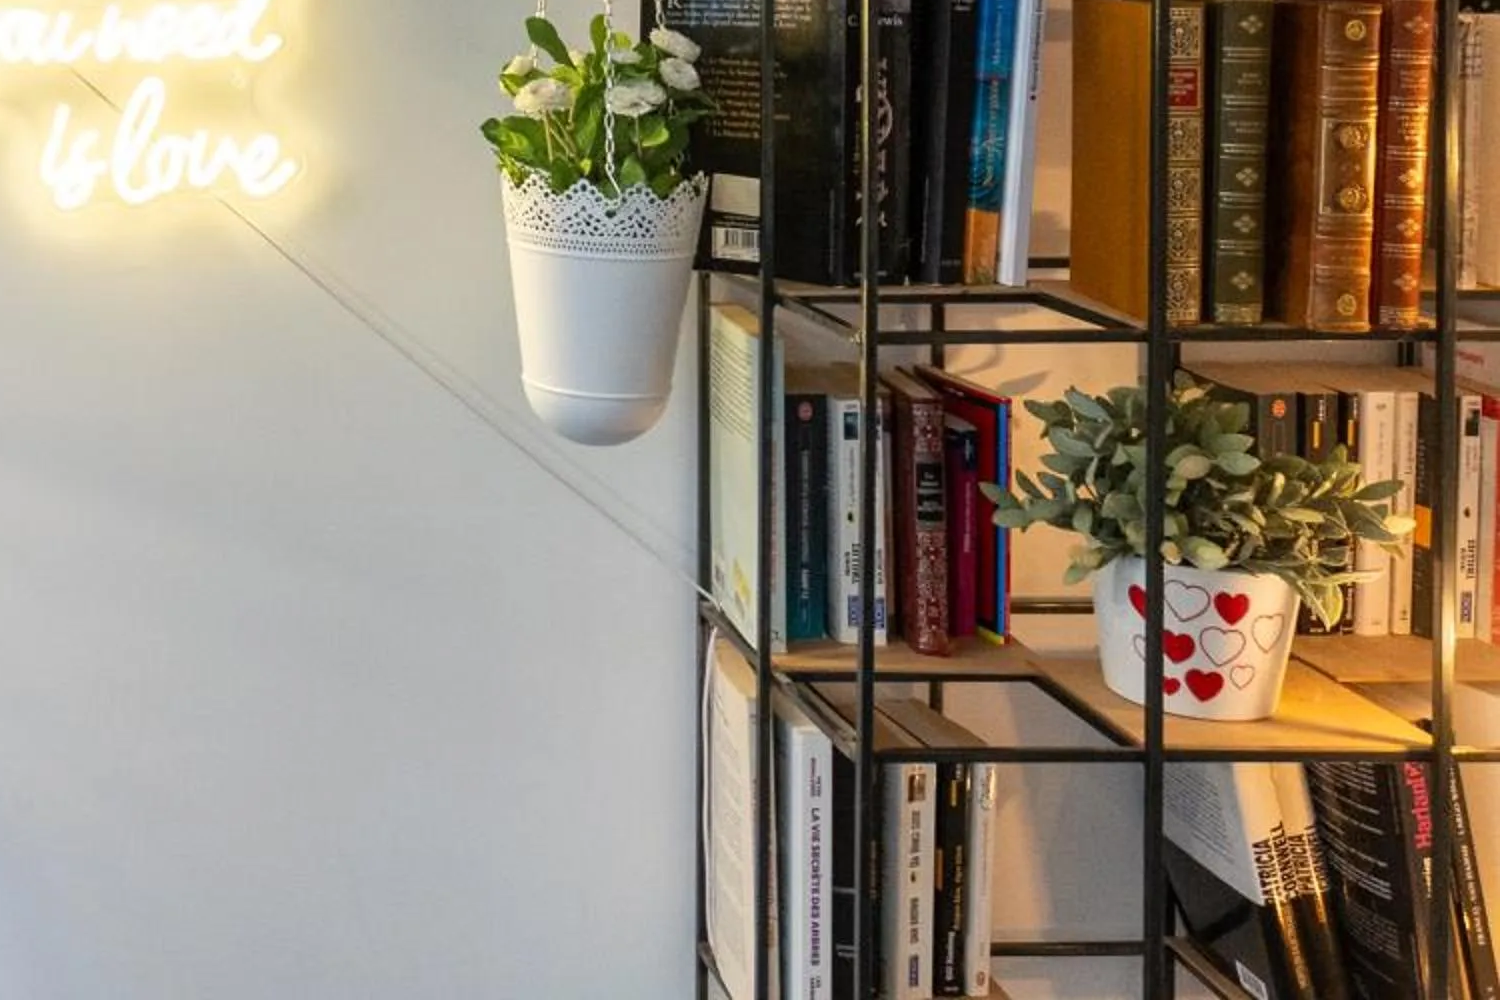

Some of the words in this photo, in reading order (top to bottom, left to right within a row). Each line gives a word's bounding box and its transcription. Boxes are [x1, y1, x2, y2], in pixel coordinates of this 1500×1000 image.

[40, 104, 108, 209] is
[109, 76, 297, 205] love
[810, 807, 821, 823] LA
[810, 825, 821, 843] VIE
[810, 897, 821, 918] DES
[810, 920, 821, 966] ARBRES
